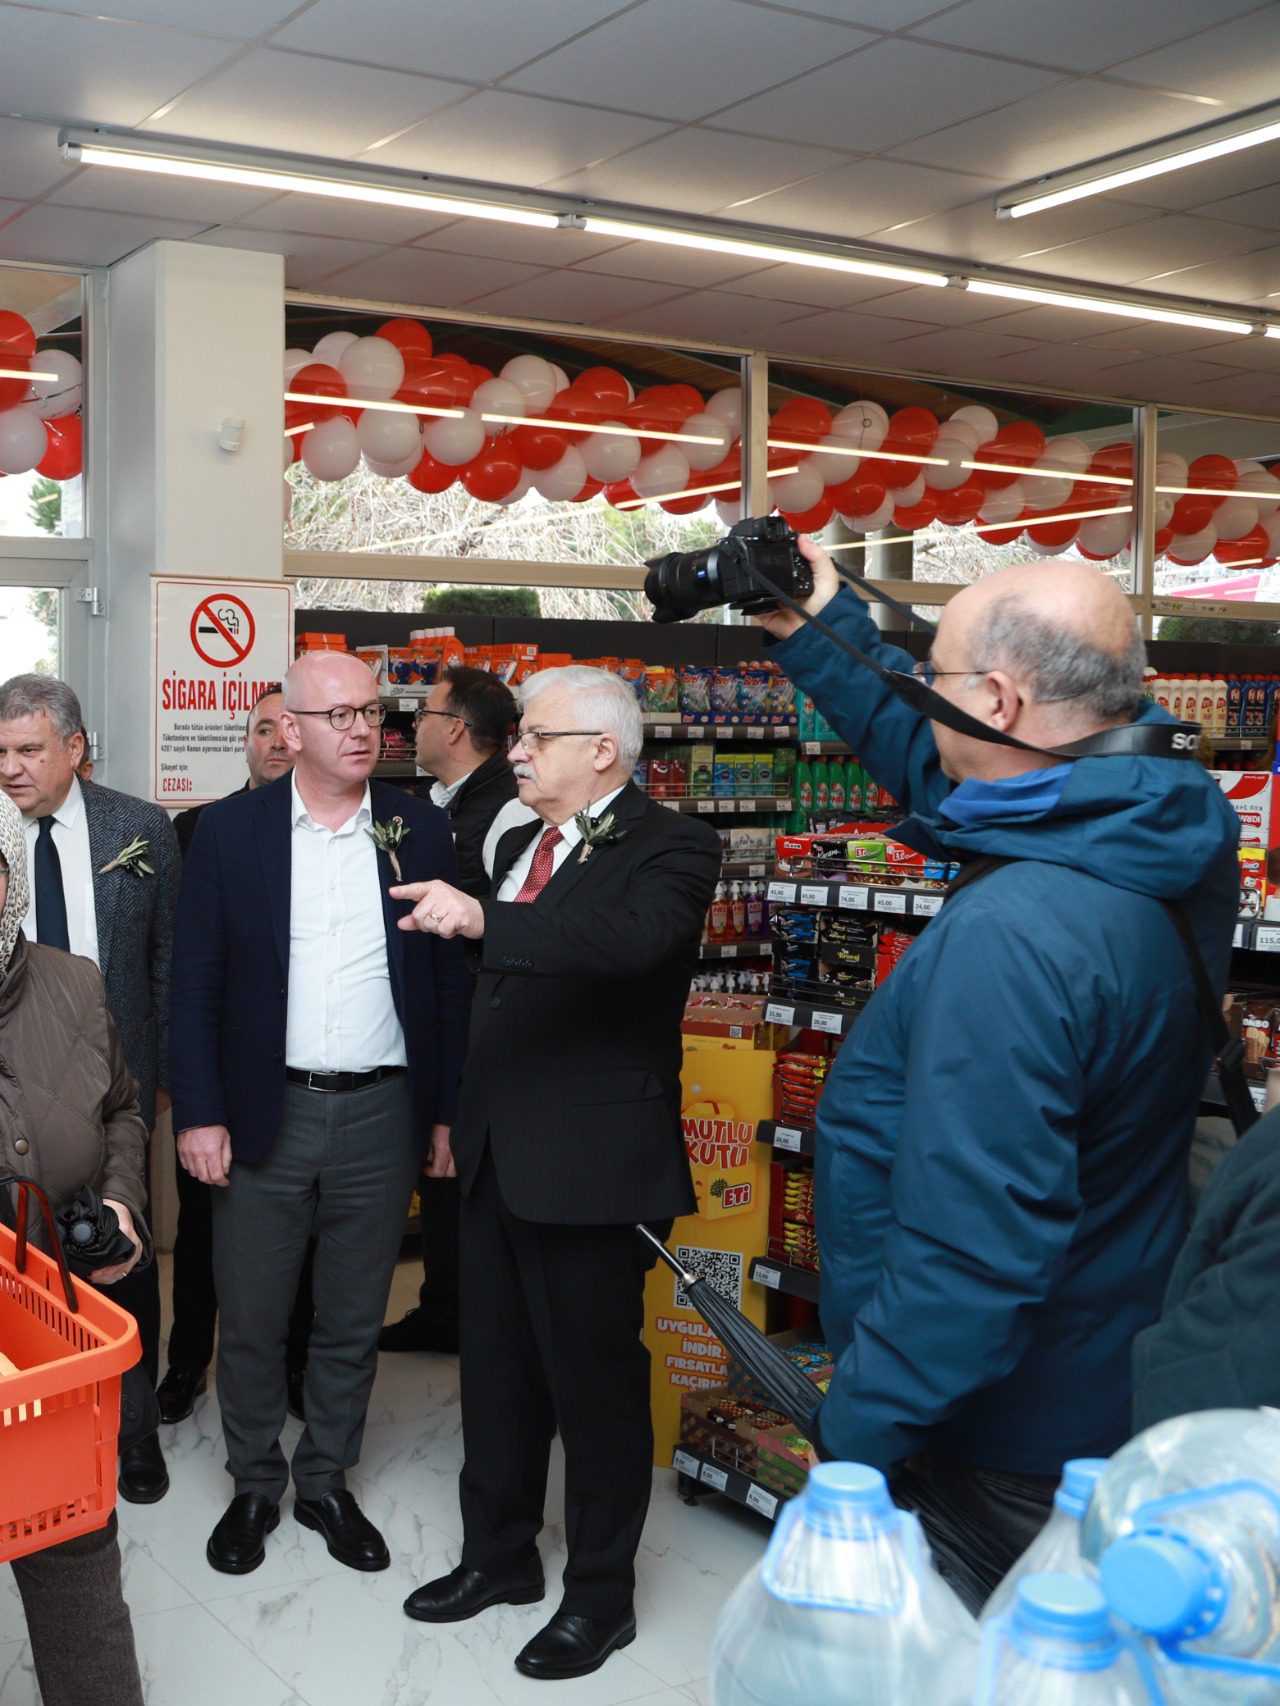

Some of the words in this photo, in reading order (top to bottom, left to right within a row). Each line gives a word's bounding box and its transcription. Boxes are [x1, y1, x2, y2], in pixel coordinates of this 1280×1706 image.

[162, 669, 217, 710] SİGARA
[222, 671, 276, 720] İÇİLM
[162, 777, 192, 792] CEZASI:
[681, 1118, 753, 1145] MUTLU
[685, 1140, 749, 1170] KUTU
[657, 1318, 718, 1339] UYGULA
[666, 1355, 728, 1376] FIRSATLA
[671, 1373, 729, 1391] KAÇIRM
